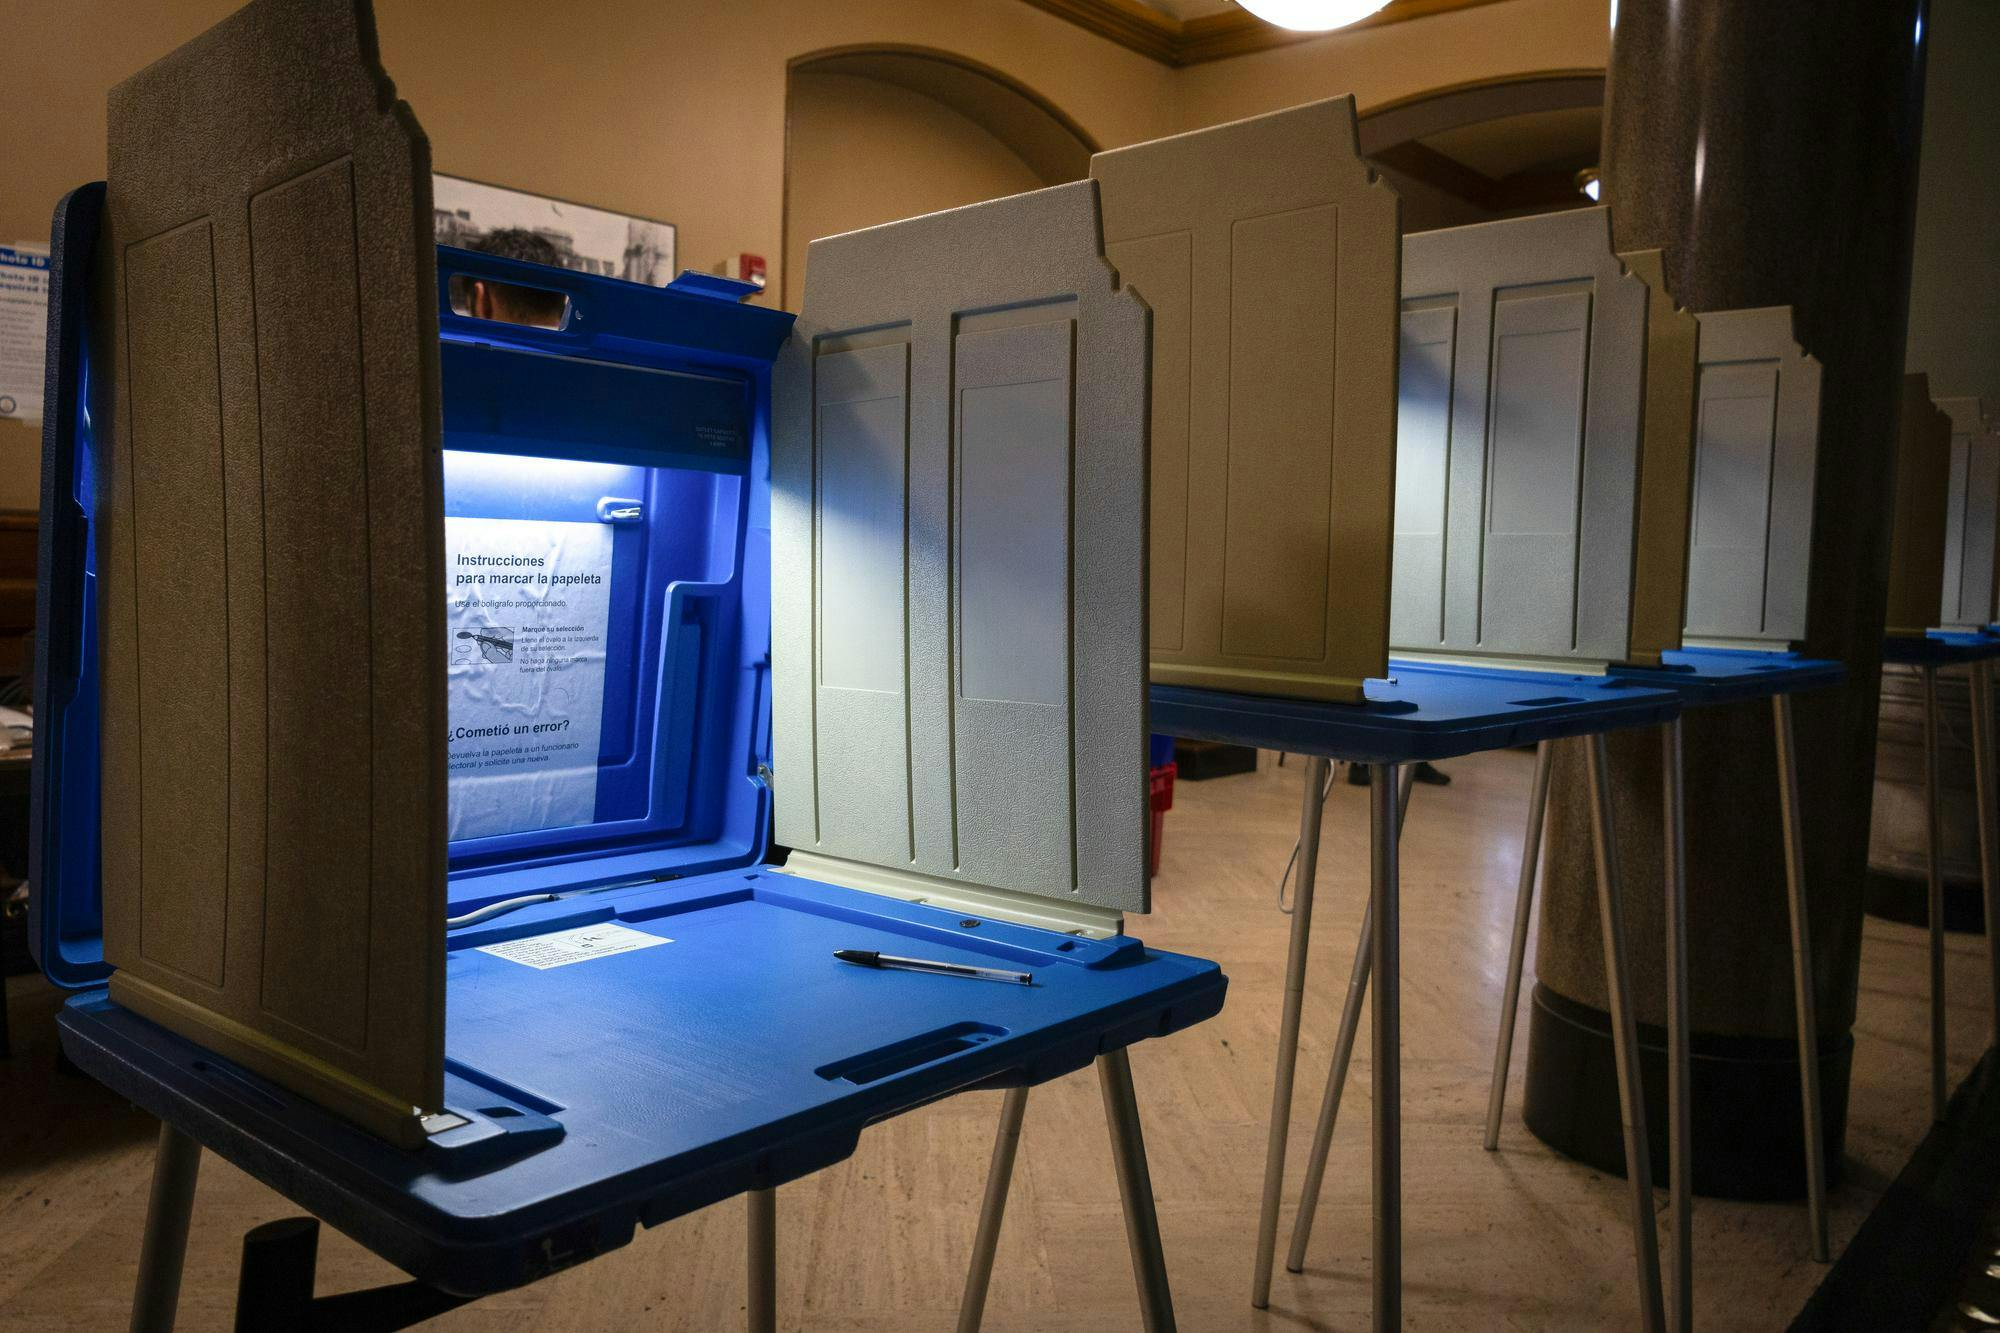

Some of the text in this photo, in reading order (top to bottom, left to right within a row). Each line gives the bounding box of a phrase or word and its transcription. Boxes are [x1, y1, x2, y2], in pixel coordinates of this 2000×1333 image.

[0, 253, 28, 265] hoto
[457, 554, 544, 567] Instrucciones
[456, 573, 601, 586] para marcar la papeleta
[455, 600, 470, 608] Use
[472, 600, 480, 608] el
[448, 720, 570, 742] ¿Cometió un error?
[482, 748, 489, 756] la
[491, 746, 522, 757] papeleta
[541, 742, 579, 751] funcionario
[484, 758, 510, 766] solicite
